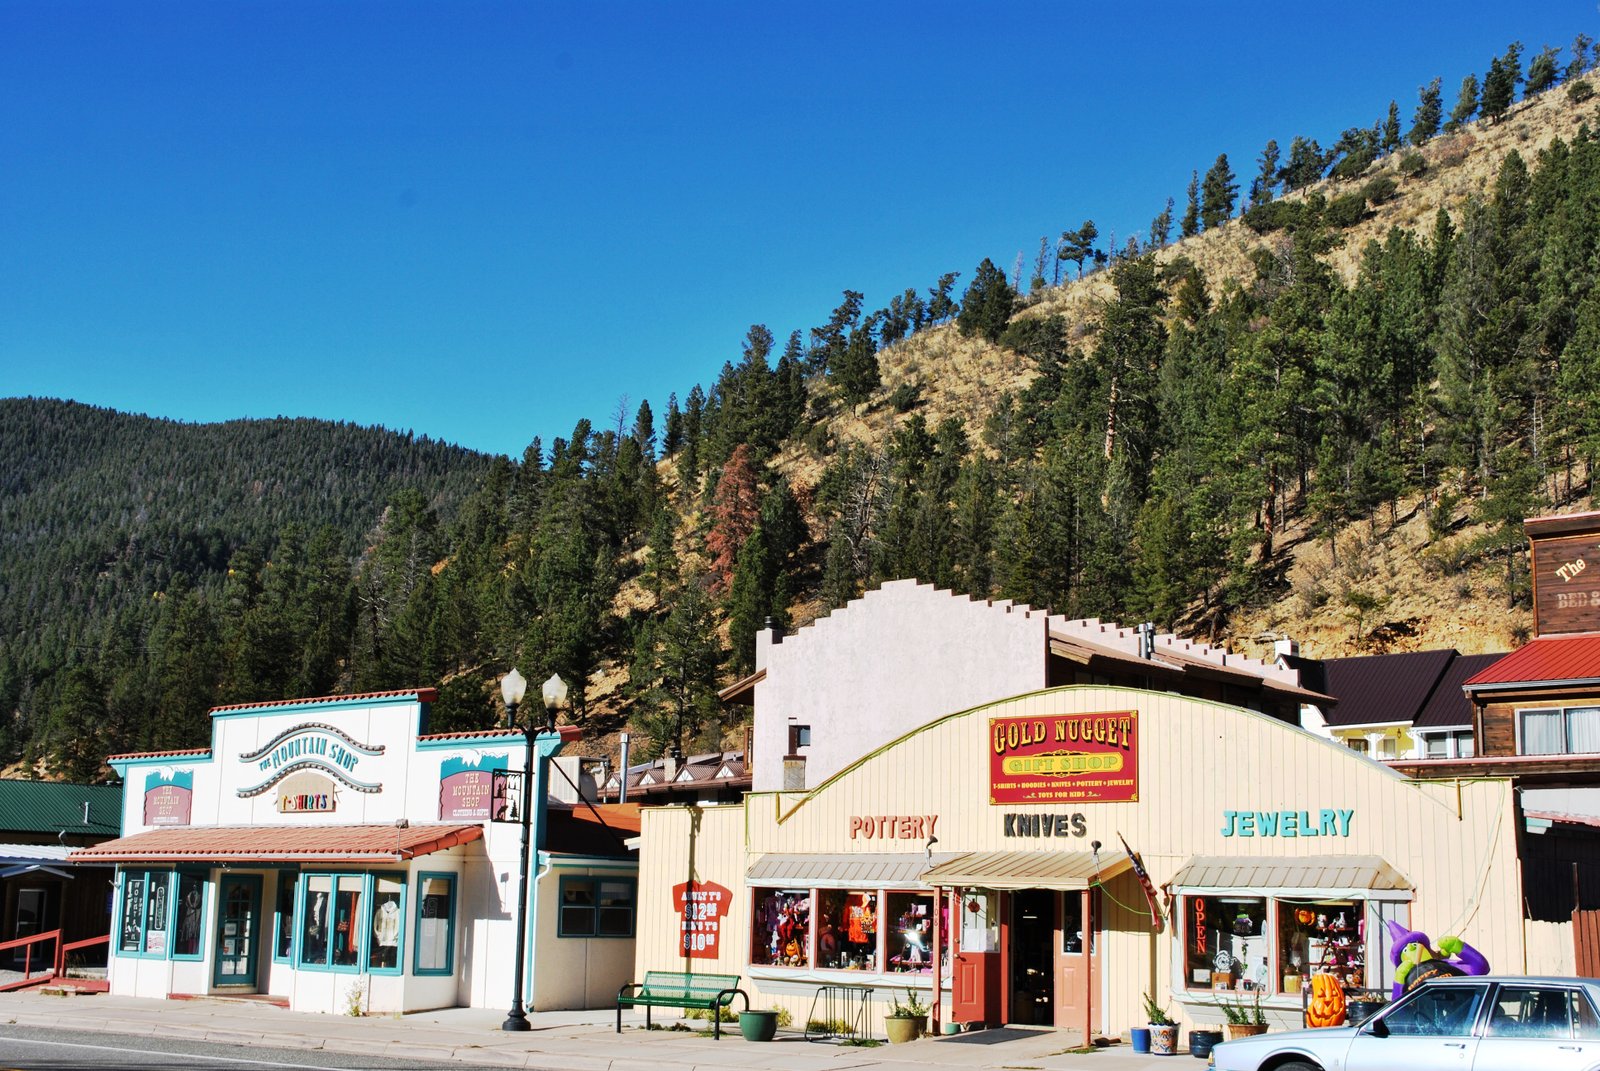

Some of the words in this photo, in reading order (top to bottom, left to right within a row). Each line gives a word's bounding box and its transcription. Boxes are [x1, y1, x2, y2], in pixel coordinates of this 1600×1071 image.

[1555, 558, 1586, 582] The
[994, 721, 1047, 756] GOLD
[1054, 716, 1132, 750] NUGGET
[258, 758, 271, 772] THE
[271, 737, 328, 769] MOUNTAIN
[329, 743, 359, 772] SHOP
[1009, 758, 1054, 772] GIFT
[1060, 756, 1118, 770] SHOP
[452, 784, 490, 796] MOUNTAIN
[465, 773, 480, 784] THE
[462, 797, 480, 808] SHOP
[849, 814, 939, 840] POTTERY
[1003, 812, 1088, 839] KNIVES
[1220, 808, 1354, 837] JEWELRY
[681, 892, 707, 901] ADULT
[1195, 898, 1207, 954] OPEN
